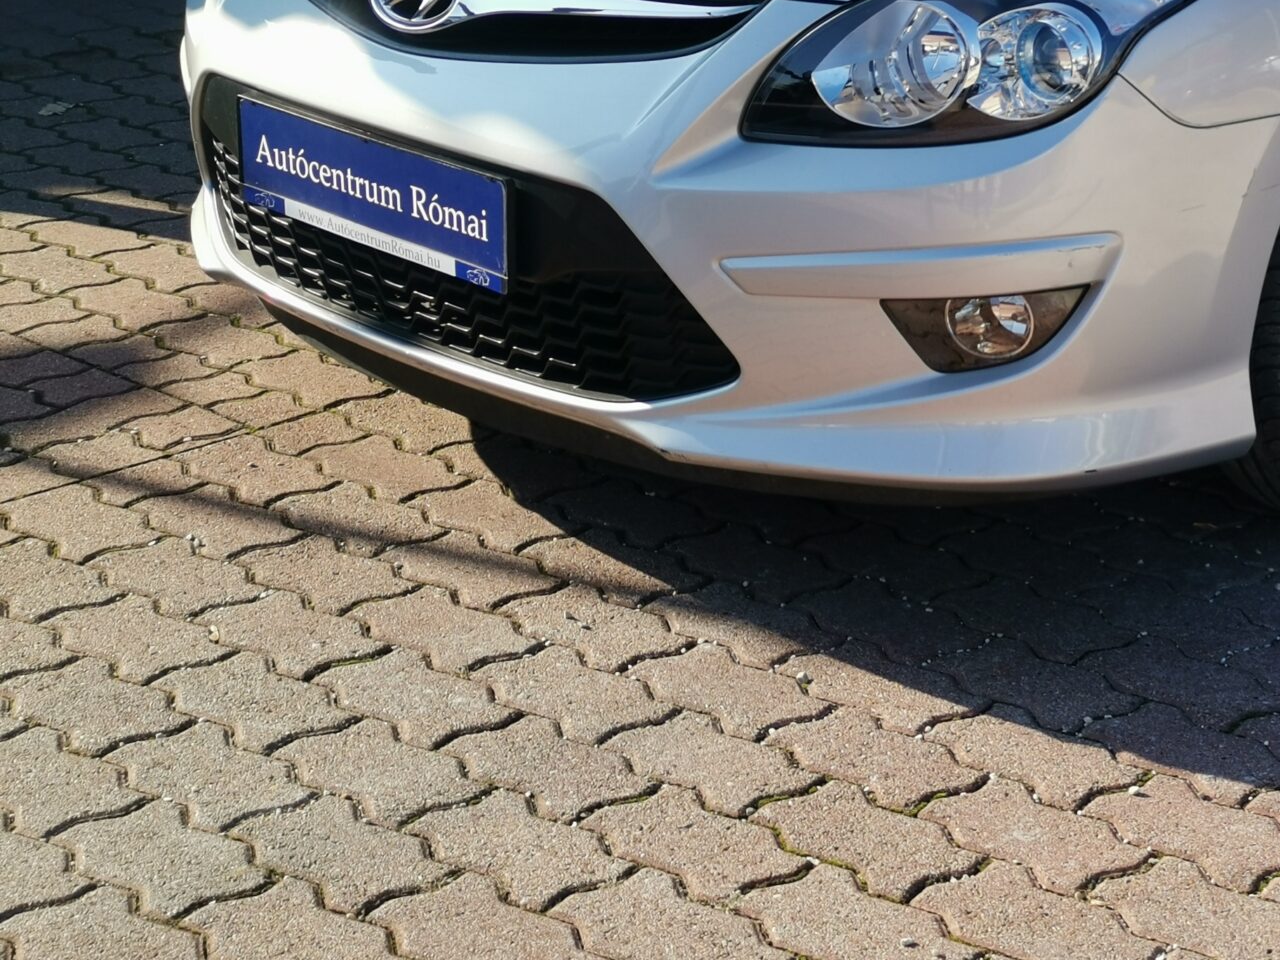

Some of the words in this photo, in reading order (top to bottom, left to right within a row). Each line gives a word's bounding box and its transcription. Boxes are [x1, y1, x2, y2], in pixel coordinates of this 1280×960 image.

[256, 134, 403, 213] Autócentrum
[410, 185, 488, 242] Római
[298, 208, 441, 269] www.AutócentrumRómai.hu
